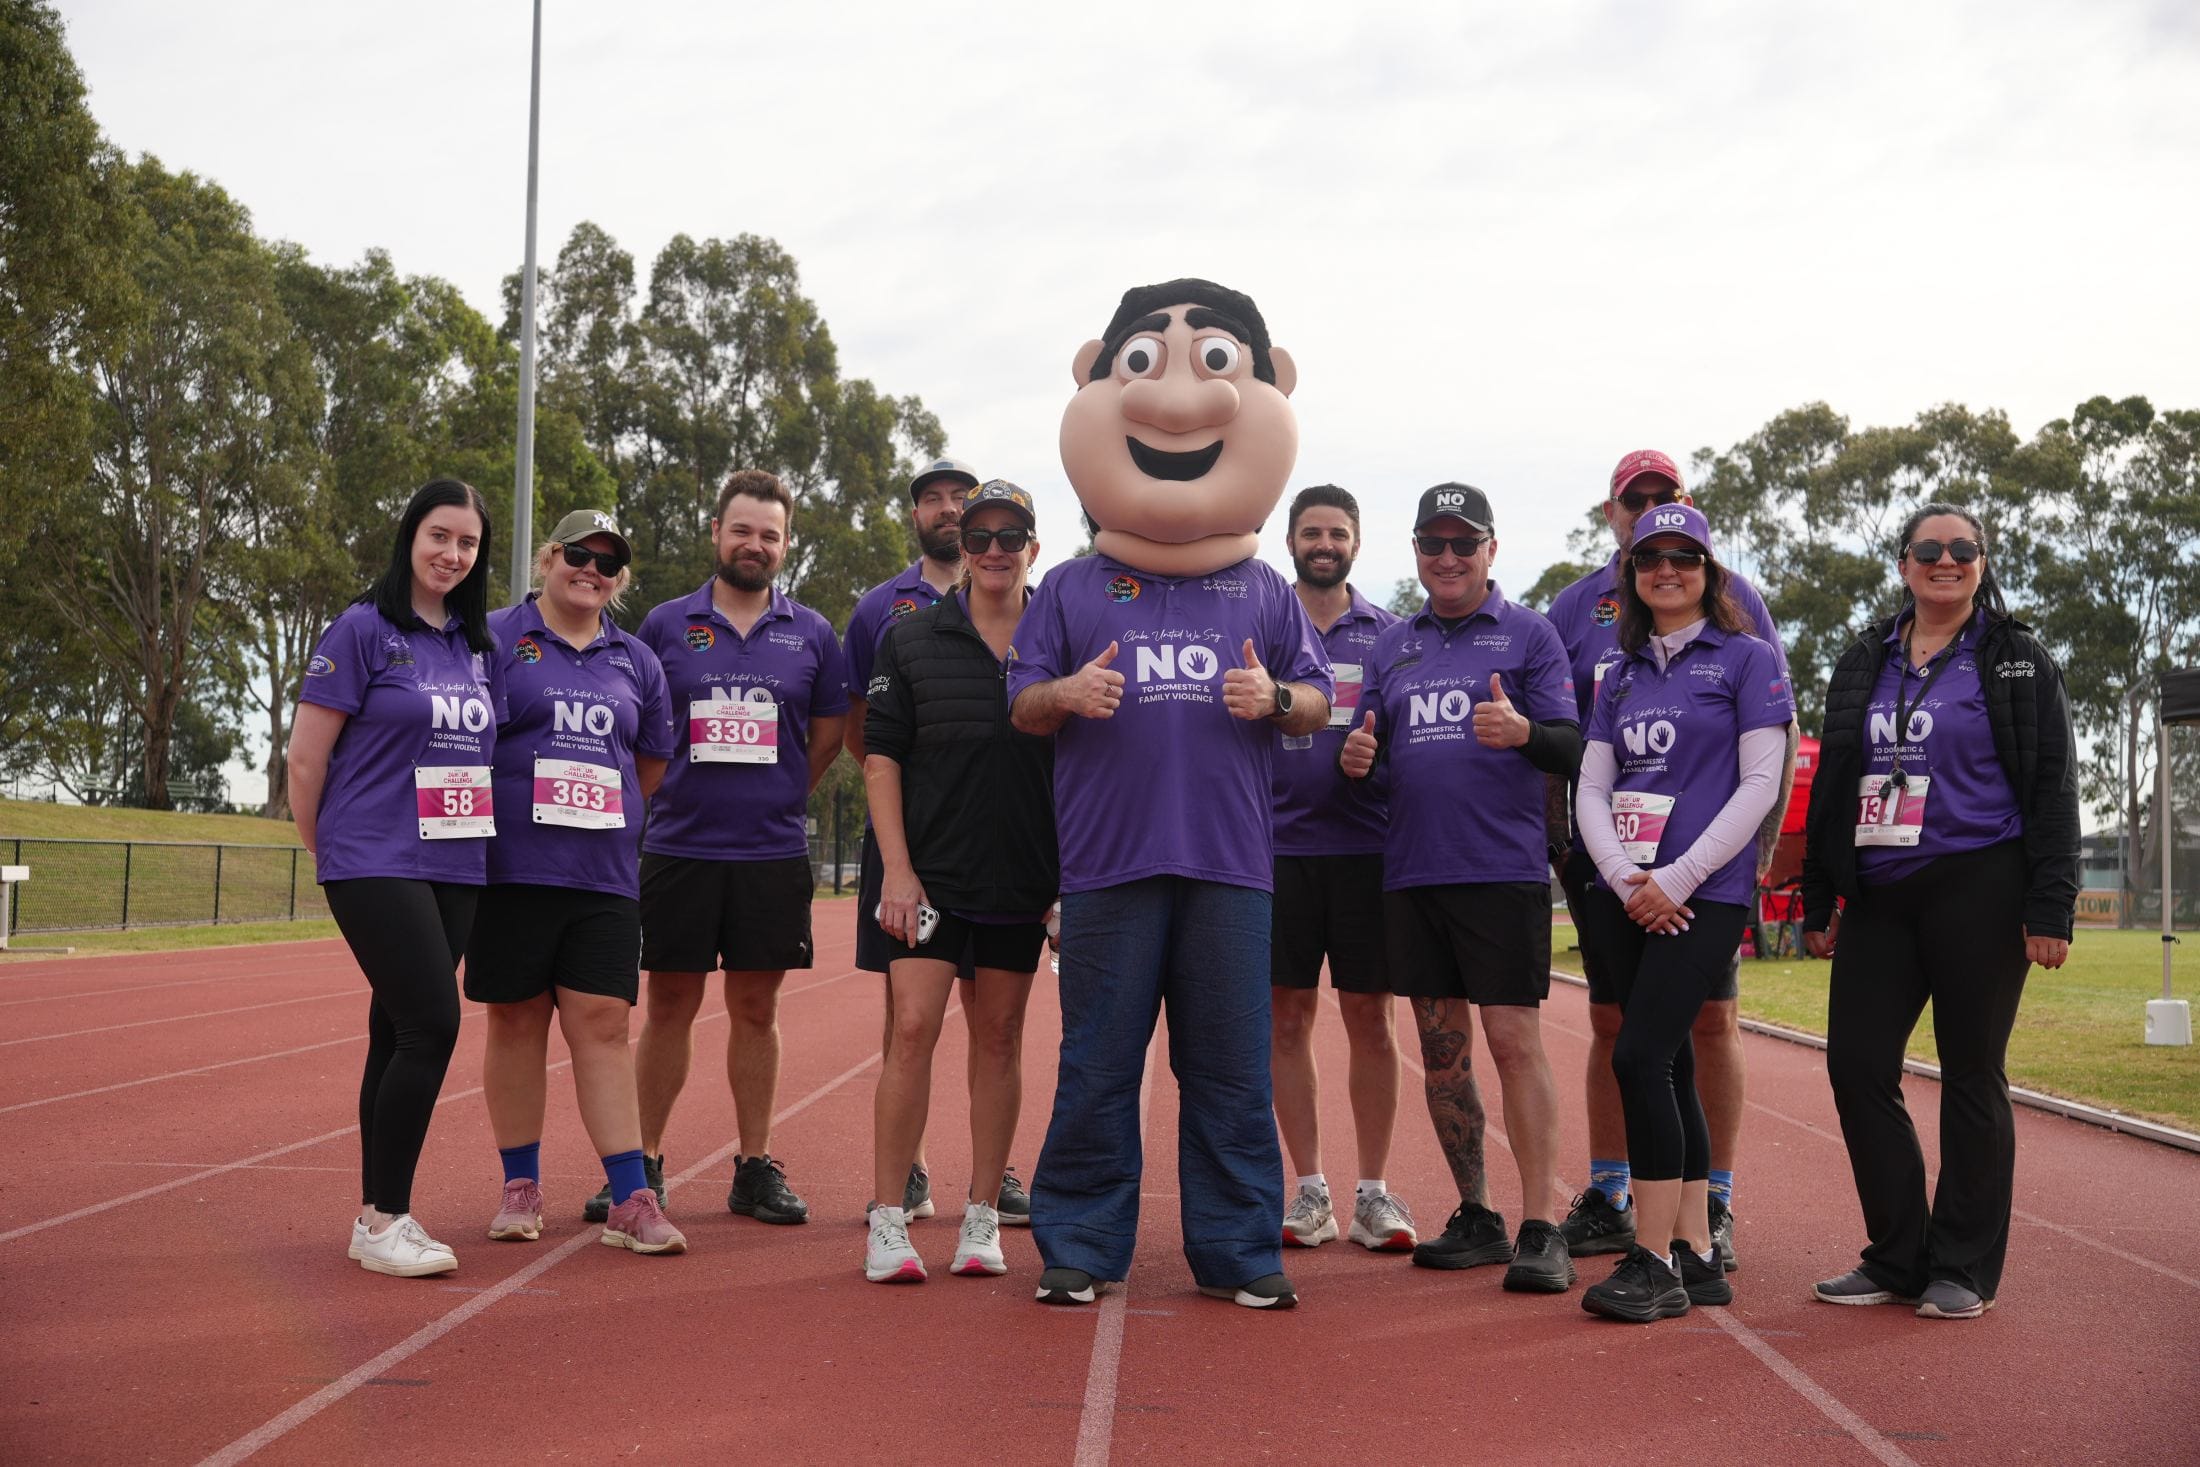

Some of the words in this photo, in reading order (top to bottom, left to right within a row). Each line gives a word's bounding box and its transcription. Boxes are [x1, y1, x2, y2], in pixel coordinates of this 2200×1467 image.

[1436, 492, 1465, 506] NO
[1655, 512, 1686, 526] NO
[1202, 583, 1248, 592] workers'
[1122, 629, 1150, 643] Clubs
[1151, 628, 1184, 642] United
[1185, 629, 1201, 642] We
[1347, 637, 1375, 646] worke
[1472, 638, 1512, 646] workers'
[1136, 644, 1219, 682] NO
[700, 673, 722, 684] Clubs
[724, 673, 749, 683] United
[751, 675, 764, 684] We
[1424, 678, 1449, 690] United
[440, 683, 464, 694] United
[543, 687, 564, 697] Clubs
[566, 688, 592, 699] United
[1142, 685, 1154, 693] TO
[1155, 684, 1202, 692] DOMESTIC
[1138, 692, 1171, 704] FAMILY
[1172, 693, 1214, 703] VIOLENCE
[431, 695, 489, 733] NO
[1409, 689, 1471, 727] NO
[553, 700, 615, 736] NO
[706, 719, 760, 744] 330
[1421, 725, 1456, 734] DOMESTIC
[1870, 710, 1934, 744] NO
[443, 734, 474, 743] DOMESTIC
[566, 735, 600, 744] DOMESTIC
[1409, 735, 1431, 744] FAMILY
[1432, 733, 1466, 741] VIOLENCE
[1623, 720, 1676, 755] NO
[428, 741, 453, 749] FAMILY
[453, 744, 481, 753] VIOLENCE
[551, 741, 577, 749] FAMILY
[577, 744, 608, 754] VIOLENCE
[563, 770, 598, 781] CHALLENGE
[552, 780, 606, 810] 363
[443, 789, 474, 816] 58
[1861, 797, 1882, 824] 13
[1616, 814, 1640, 841] 60
